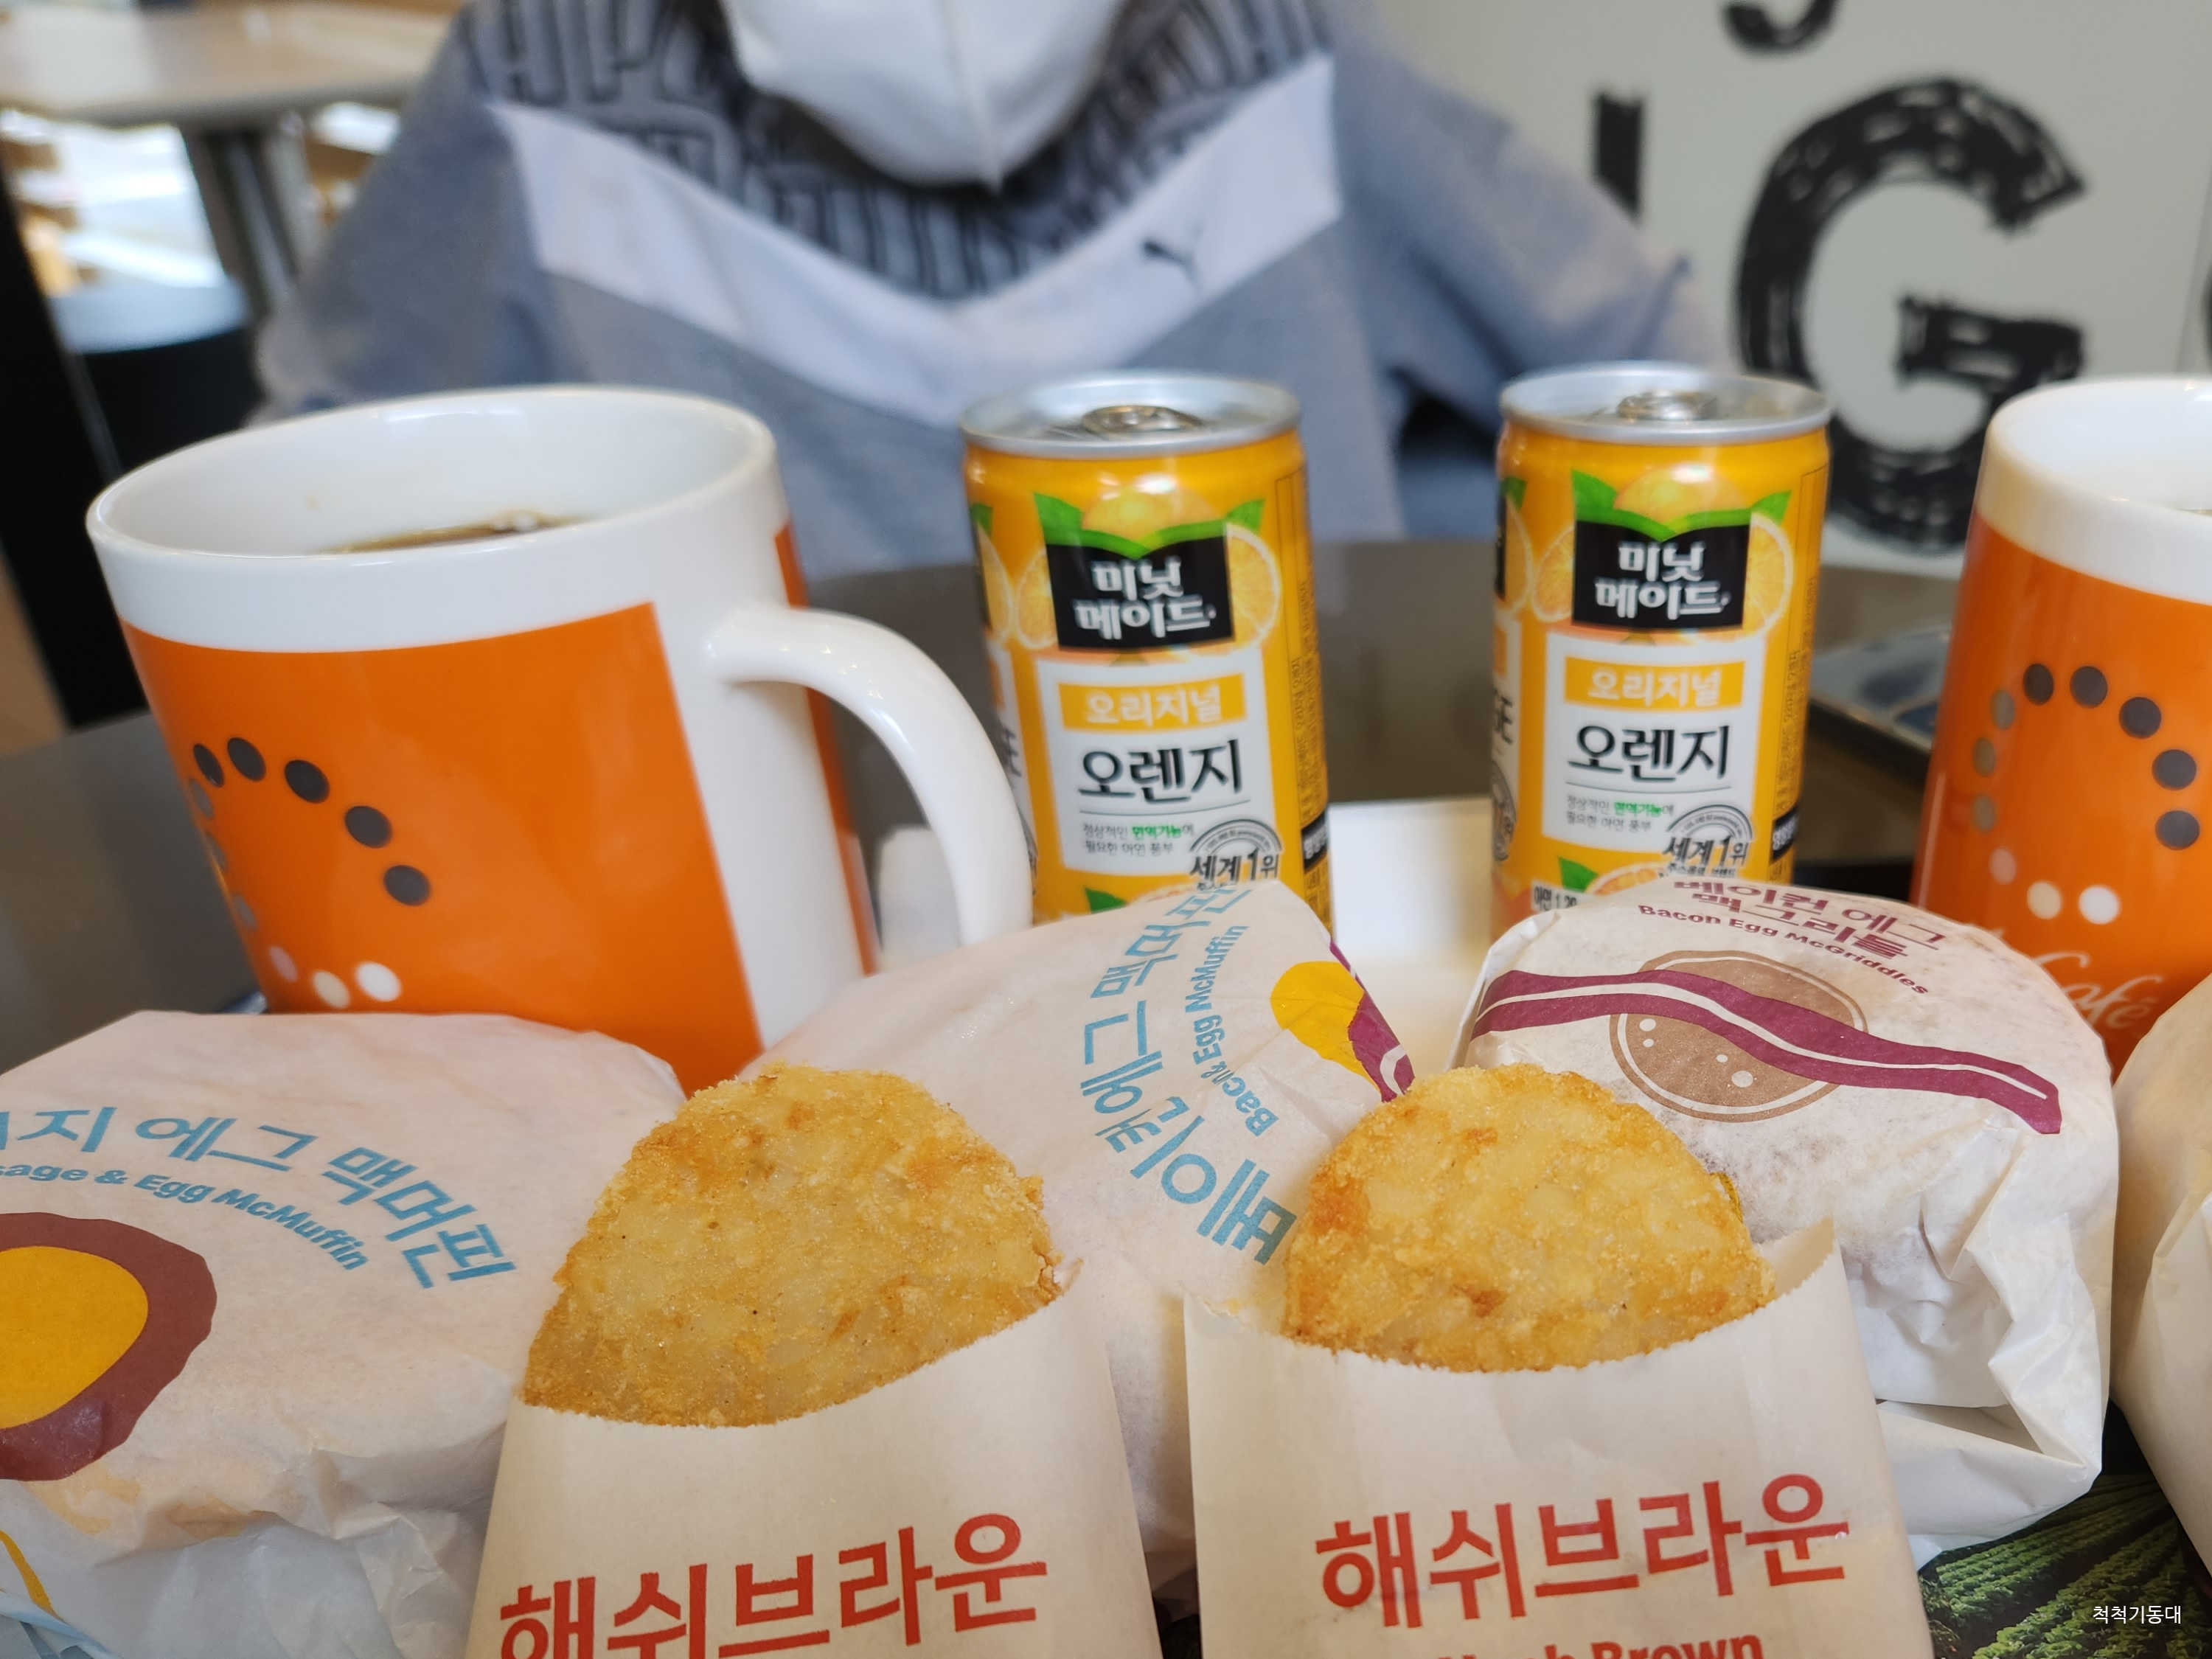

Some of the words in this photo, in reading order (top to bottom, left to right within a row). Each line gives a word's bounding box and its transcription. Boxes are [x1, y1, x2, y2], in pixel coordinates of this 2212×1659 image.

[1091, 555, 1184, 601] 미닛
[1617, 540, 1705, 582] 미닛
[1072, 596, 1212, 640] 메이드
[1593, 577, 1725, 620] 메이드
[1085, 683, 1223, 727] 오리지널
[1587, 666, 1722, 707] 오리지널
[1077, 739, 1242, 805] 오렌지
[1567, 725, 1730, 784] 오렌지
[1673, 880, 1830, 915] 베이컨
[1840, 908, 1946, 951] 에그
[1691, 892, 1908, 959] 맥그리들
[1184, 925, 1250, 1014] McMuffin
[1637, 904, 1722, 925] Bacon
[1727, 917, 1779, 939] Egg
[1783, 931, 1930, 995] McGriddles
[1079, 1000, 1164, 1114] 에그
[1192, 1015, 1225, 1065] Egg
[1211, 1069, 1279, 1136] Bacn
[0, 1164, 89, 1182] age
[93, 1169, 130, 1185] &
[133, 1174, 216, 1204] Egg
[210, 1188, 369, 1271] McMuffin
[134, 1116, 319, 1172] 에그
[321, 1147, 517, 1290] 맥머핀
[1315, 1472, 1850, 1630] 해쉬브라운
[499, 1512, 1048, 1659] 해쉬브라운
